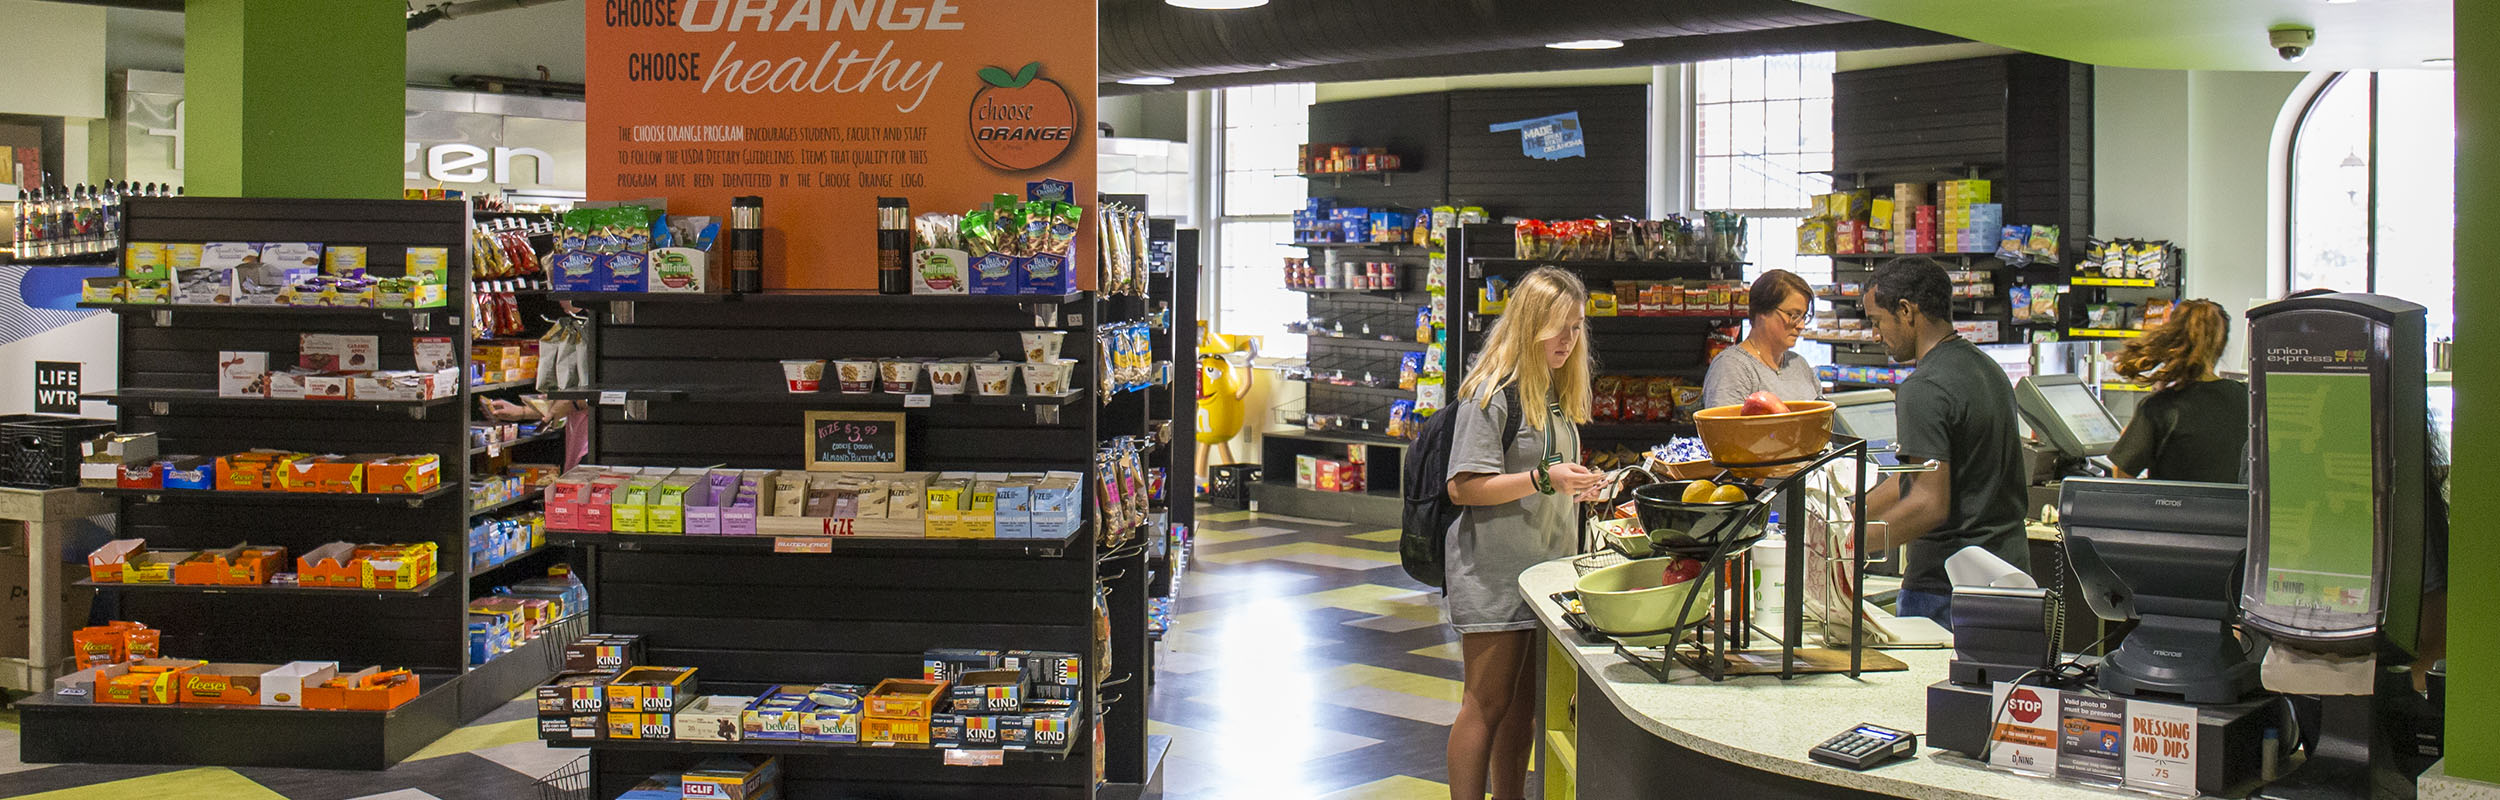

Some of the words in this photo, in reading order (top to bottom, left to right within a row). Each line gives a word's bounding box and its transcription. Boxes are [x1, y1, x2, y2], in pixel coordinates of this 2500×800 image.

[606, 0, 677, 27] CHOOSE
[678, 0, 965, 32] ORANGE
[629, 53, 700, 81] CHOOSE
[702, 40, 944, 113] healthy
[979, 96, 1035, 120] choose
[633, 125, 665, 141] CHOOSE
[667, 125, 702, 141] ORANGE
[703, 125, 744, 141] PROGRAM
[745, 127, 798, 142] ENCOURAGES
[800, 127, 844, 143] STUDENTS,
[847, 127, 881, 141] FACULTY
[884, 127, 902, 141] AND
[904, 127, 928, 141] STAFF
[978, 127, 1072, 141] ORANGE
[1524, 125, 1553, 139] MADE
[1525, 137, 1544, 149] THE
[1544, 139, 1583, 152] OKLAHOMA
[618, 150, 629, 165] TO
[631, 150, 662, 165] FOLLOW
[666, 150, 679, 165] THE
[681, 149, 704, 165] USDA
[706, 149, 740, 165] DIETARY
[743, 149, 798, 165] GUIDELINES.
[801, 149, 827, 165] ITEMS
[830, 150, 850, 165] THAT
[852, 150, 889, 168] QUALIFY
[891, 150, 906, 165] FOR
[909, 150, 928, 165] THIS
[618, 173, 657, 188] PROGRAM
[665, 173, 686, 188] HAVE
[694, 173, 714, 188] BEEN
[722, 173, 771, 188] IDENTIFIED
[780, 173, 790, 188] BY
[797, 173, 811, 188] THE
[819, 172, 851, 188] CHOOSE
[859, 172, 893, 188] ORANGE
[901, 173, 927, 188] LOGO.
[2267, 347, 2309, 355] union
[2267, 356, 2333, 364] express
[40, 370, 77, 386] LIFE
[39, 389, 77, 406] WTR
[845, 424, 878, 443] $3.99
[832, 443, 852, 451] COOKIE
[822, 452, 850, 462] ALMOND
[851, 453, 877, 462] BUTTER
[2155, 499, 2182, 507] micros
[2153, 650, 2183, 658] micros
[597, 657, 622, 665] KIND
[1059, 659, 1068, 685] KIND
[187, 676, 227, 692] Reese's
[572, 699, 602, 709] KIND
[643, 698, 673, 708] KIND
[988, 698, 1018, 708] KIND
[2009, 699, 2042, 713] STOP
[2065, 698, 2080, 706] Valid
[2090, 710, 2122, 719] presented
[642, 725, 671, 735] KIND
[967, 729, 997, 739] KIND
[2133, 717, 2190, 741] DRESSING
[1035, 732, 1065, 741] KIND
[2133, 736, 2158, 755] AND
[2163, 739, 2190, 759] DIPS
[2151, 768, 2169, 779] .75
[690, 785, 713, 794] CLIF
